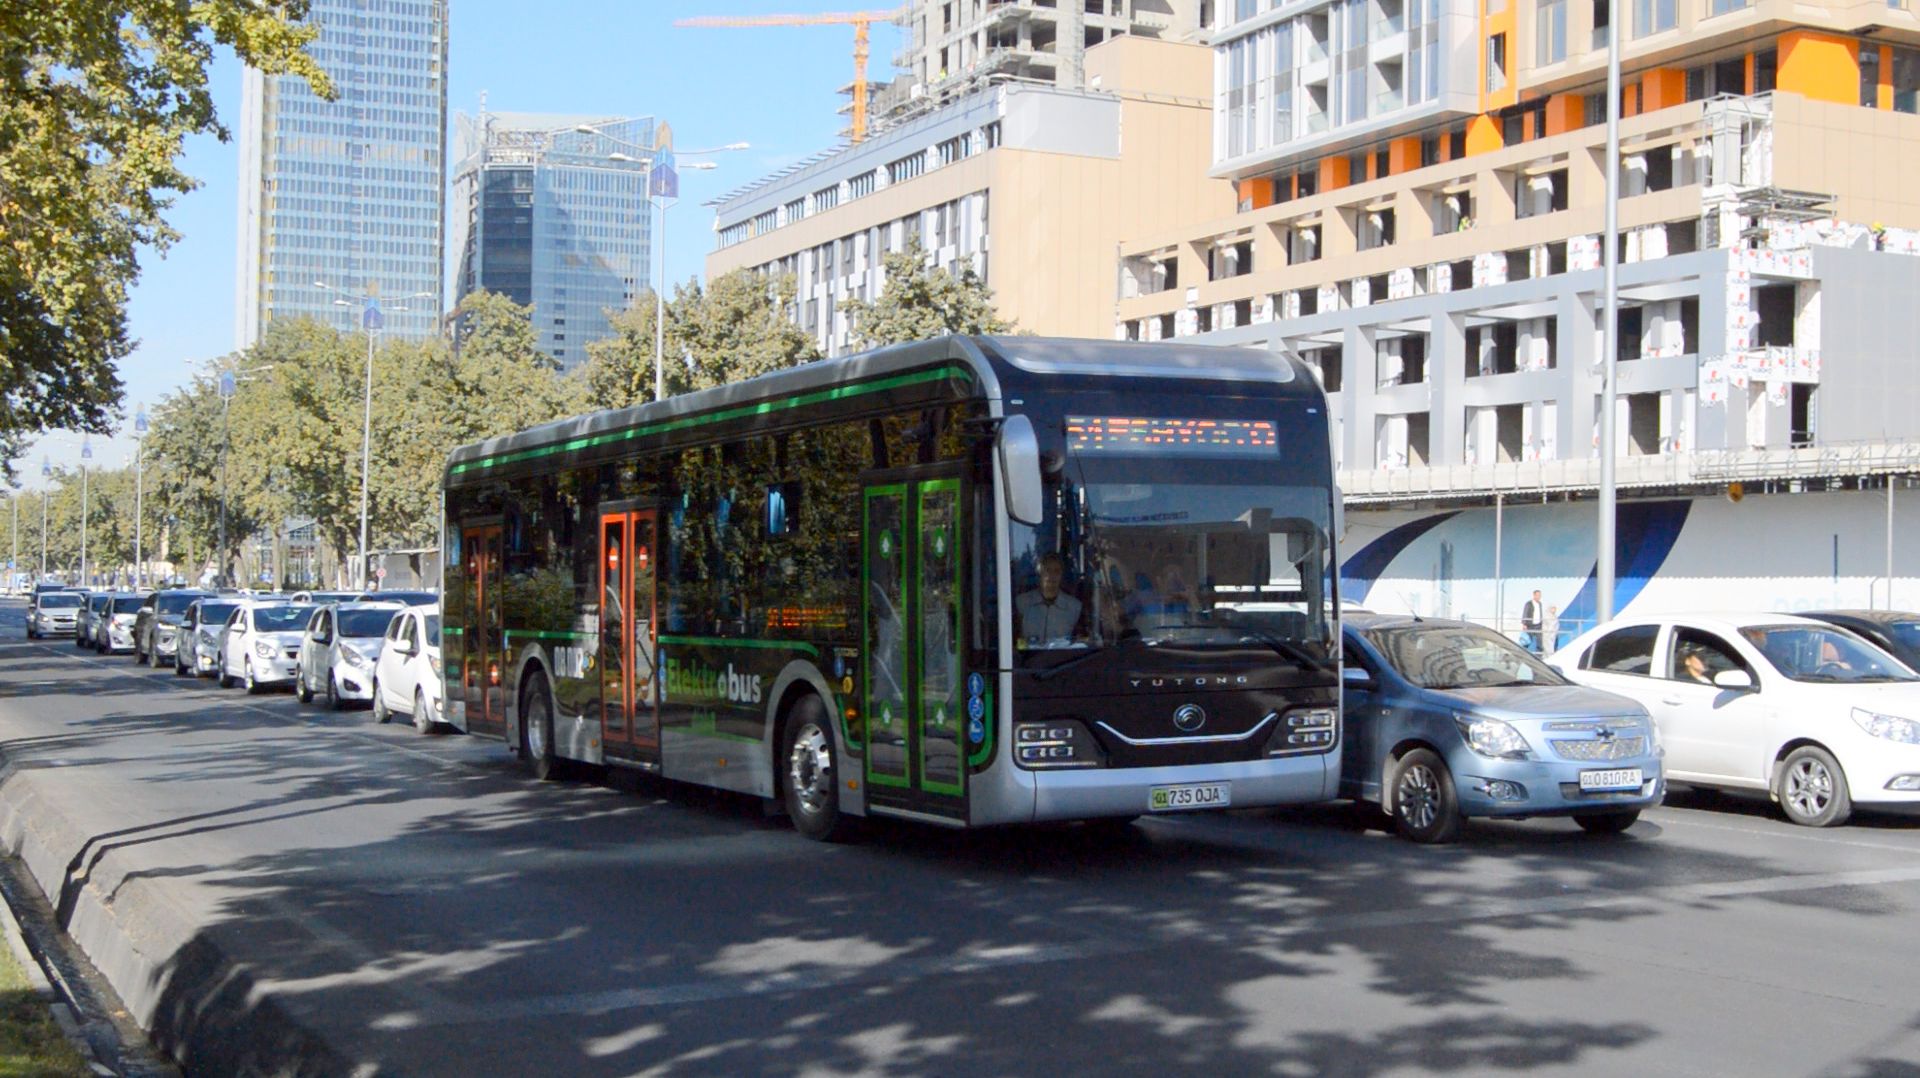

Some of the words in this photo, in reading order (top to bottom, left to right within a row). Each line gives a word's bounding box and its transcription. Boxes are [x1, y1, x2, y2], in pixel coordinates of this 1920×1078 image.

[667, 658, 761, 703] Elektrobus
[1131, 676, 1247, 687] YUTONG
[1156, 791, 1167, 804] 01
[1170, 789, 1192, 804] 735
